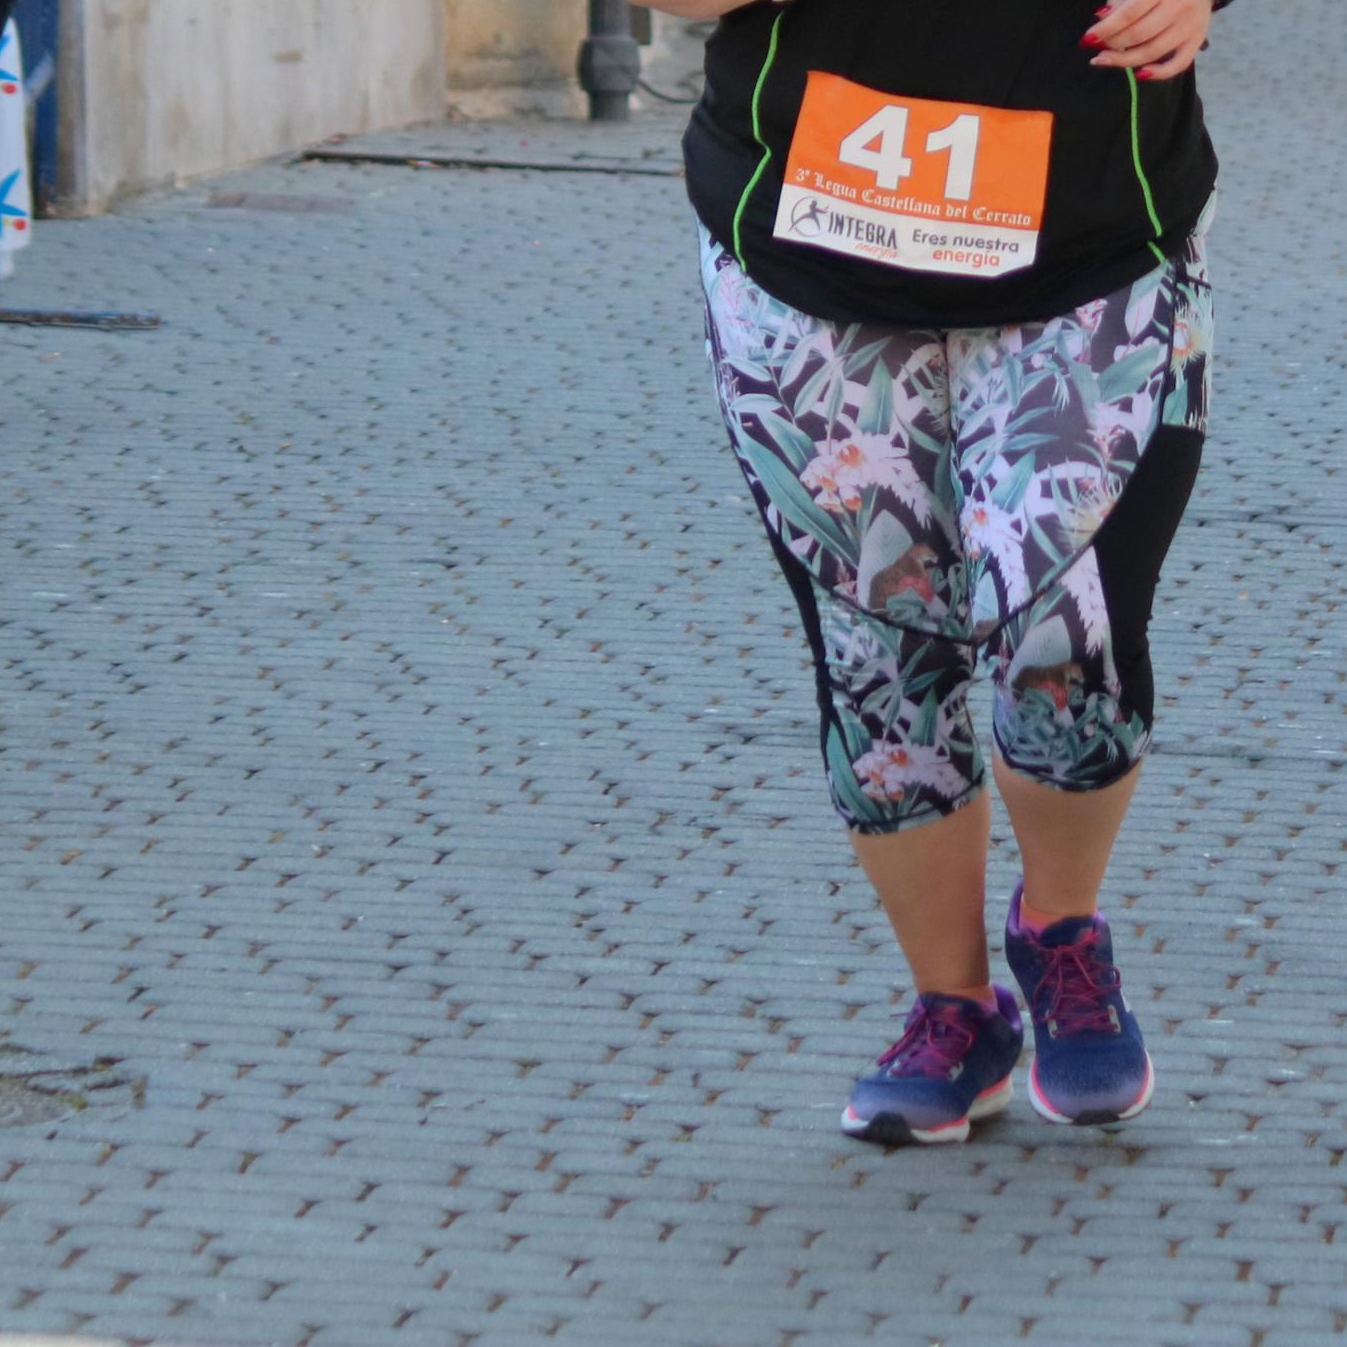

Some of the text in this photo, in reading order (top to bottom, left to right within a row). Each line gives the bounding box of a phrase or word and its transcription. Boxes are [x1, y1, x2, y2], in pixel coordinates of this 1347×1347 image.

[838, 104, 980, 201] 41
[814, 171, 858, 199] Legua
[861, 188, 941, 216] Castellana
[946, 203, 968, 219] del
[973, 206, 1032, 226] Cerrato
[828, 211, 898, 250] INTEGRA
[912, 228, 1020, 253] Eres nuestra
